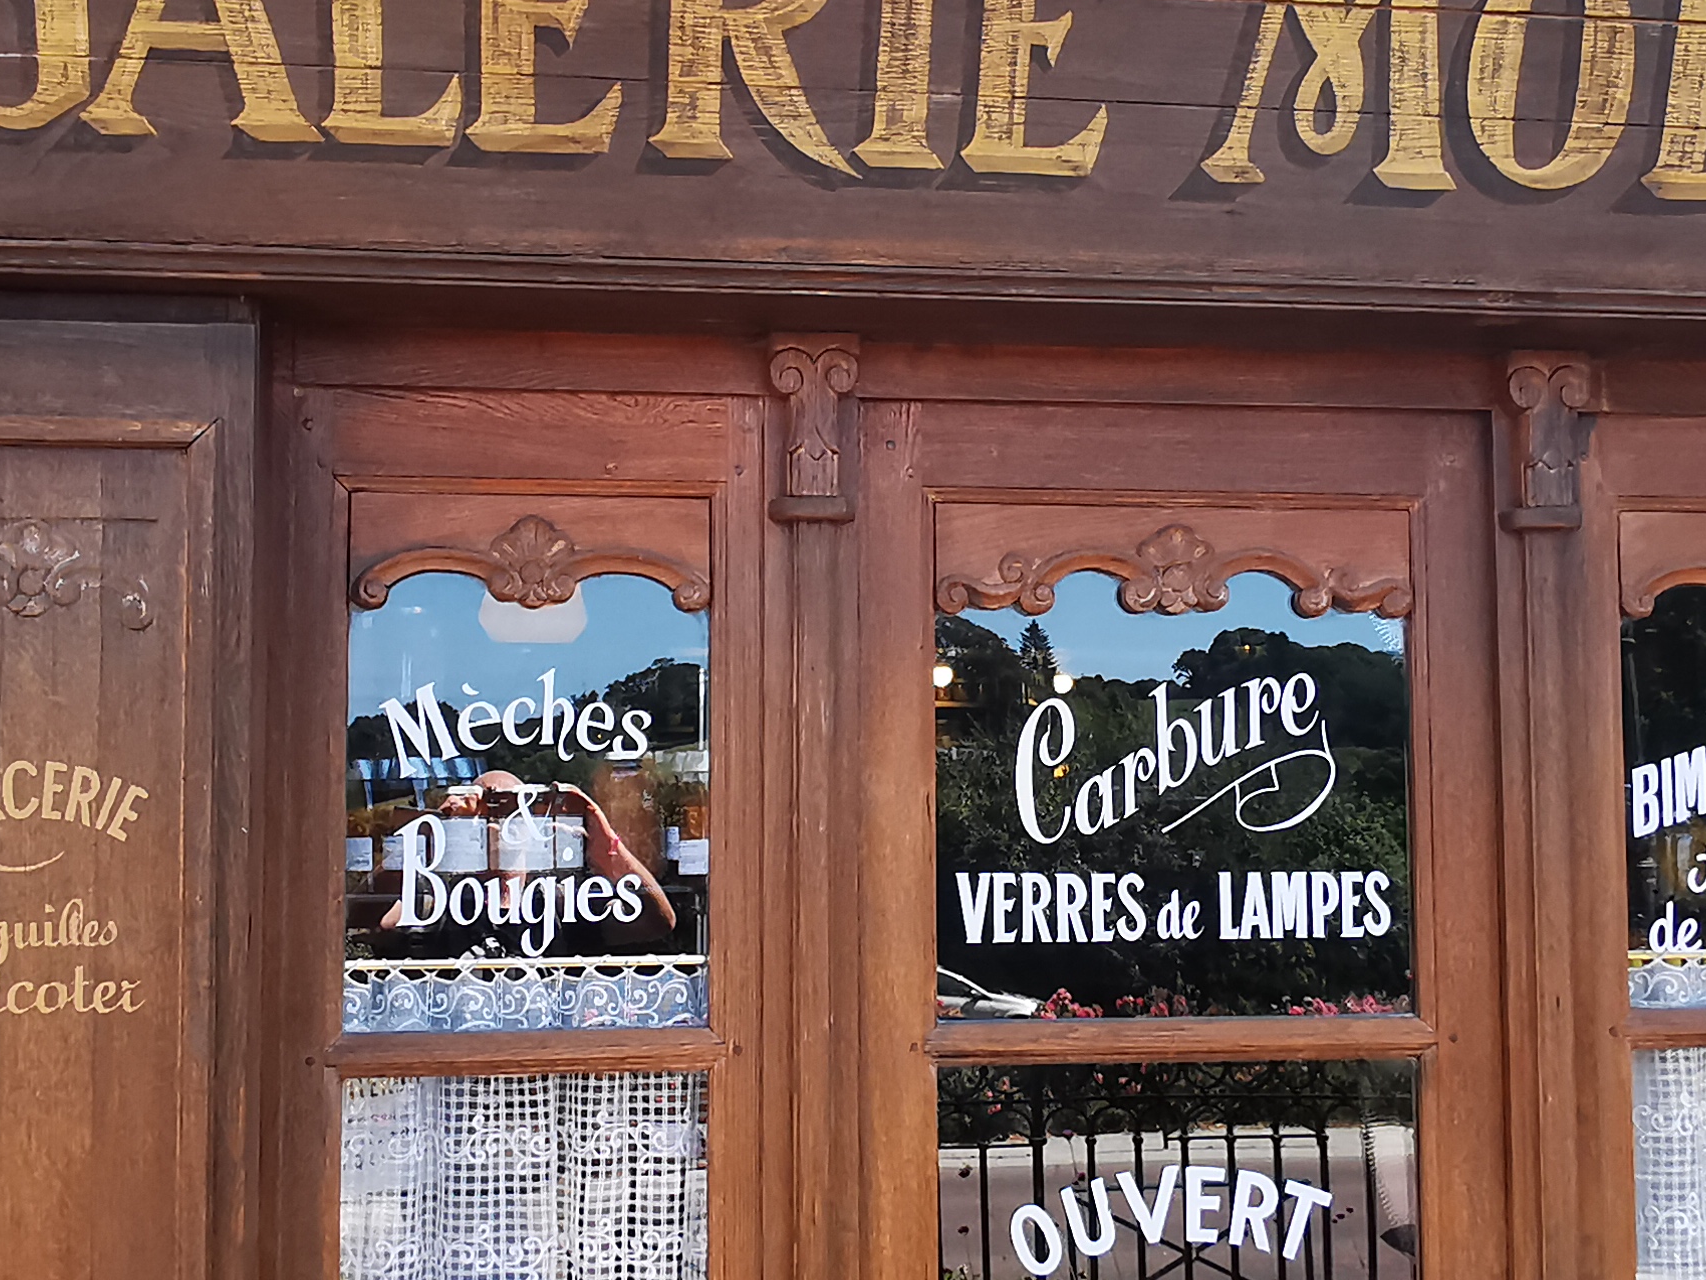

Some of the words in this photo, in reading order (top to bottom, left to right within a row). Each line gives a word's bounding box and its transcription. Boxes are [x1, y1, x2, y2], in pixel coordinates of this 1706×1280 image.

[379, 667, 652, 779] Mèches
[1014, 671, 1323, 845] Carbure
[501, 784, 554, 845] &
[393, 814, 643, 957] Bougies
[955, 871, 1148, 944] VERRES
[1156, 888, 1205, 941] de
[1217, 869, 1392, 941] LAMPES
[1649, 901, 1702, 953] de
[1009, 1165, 1333, 1277] OUVERT
